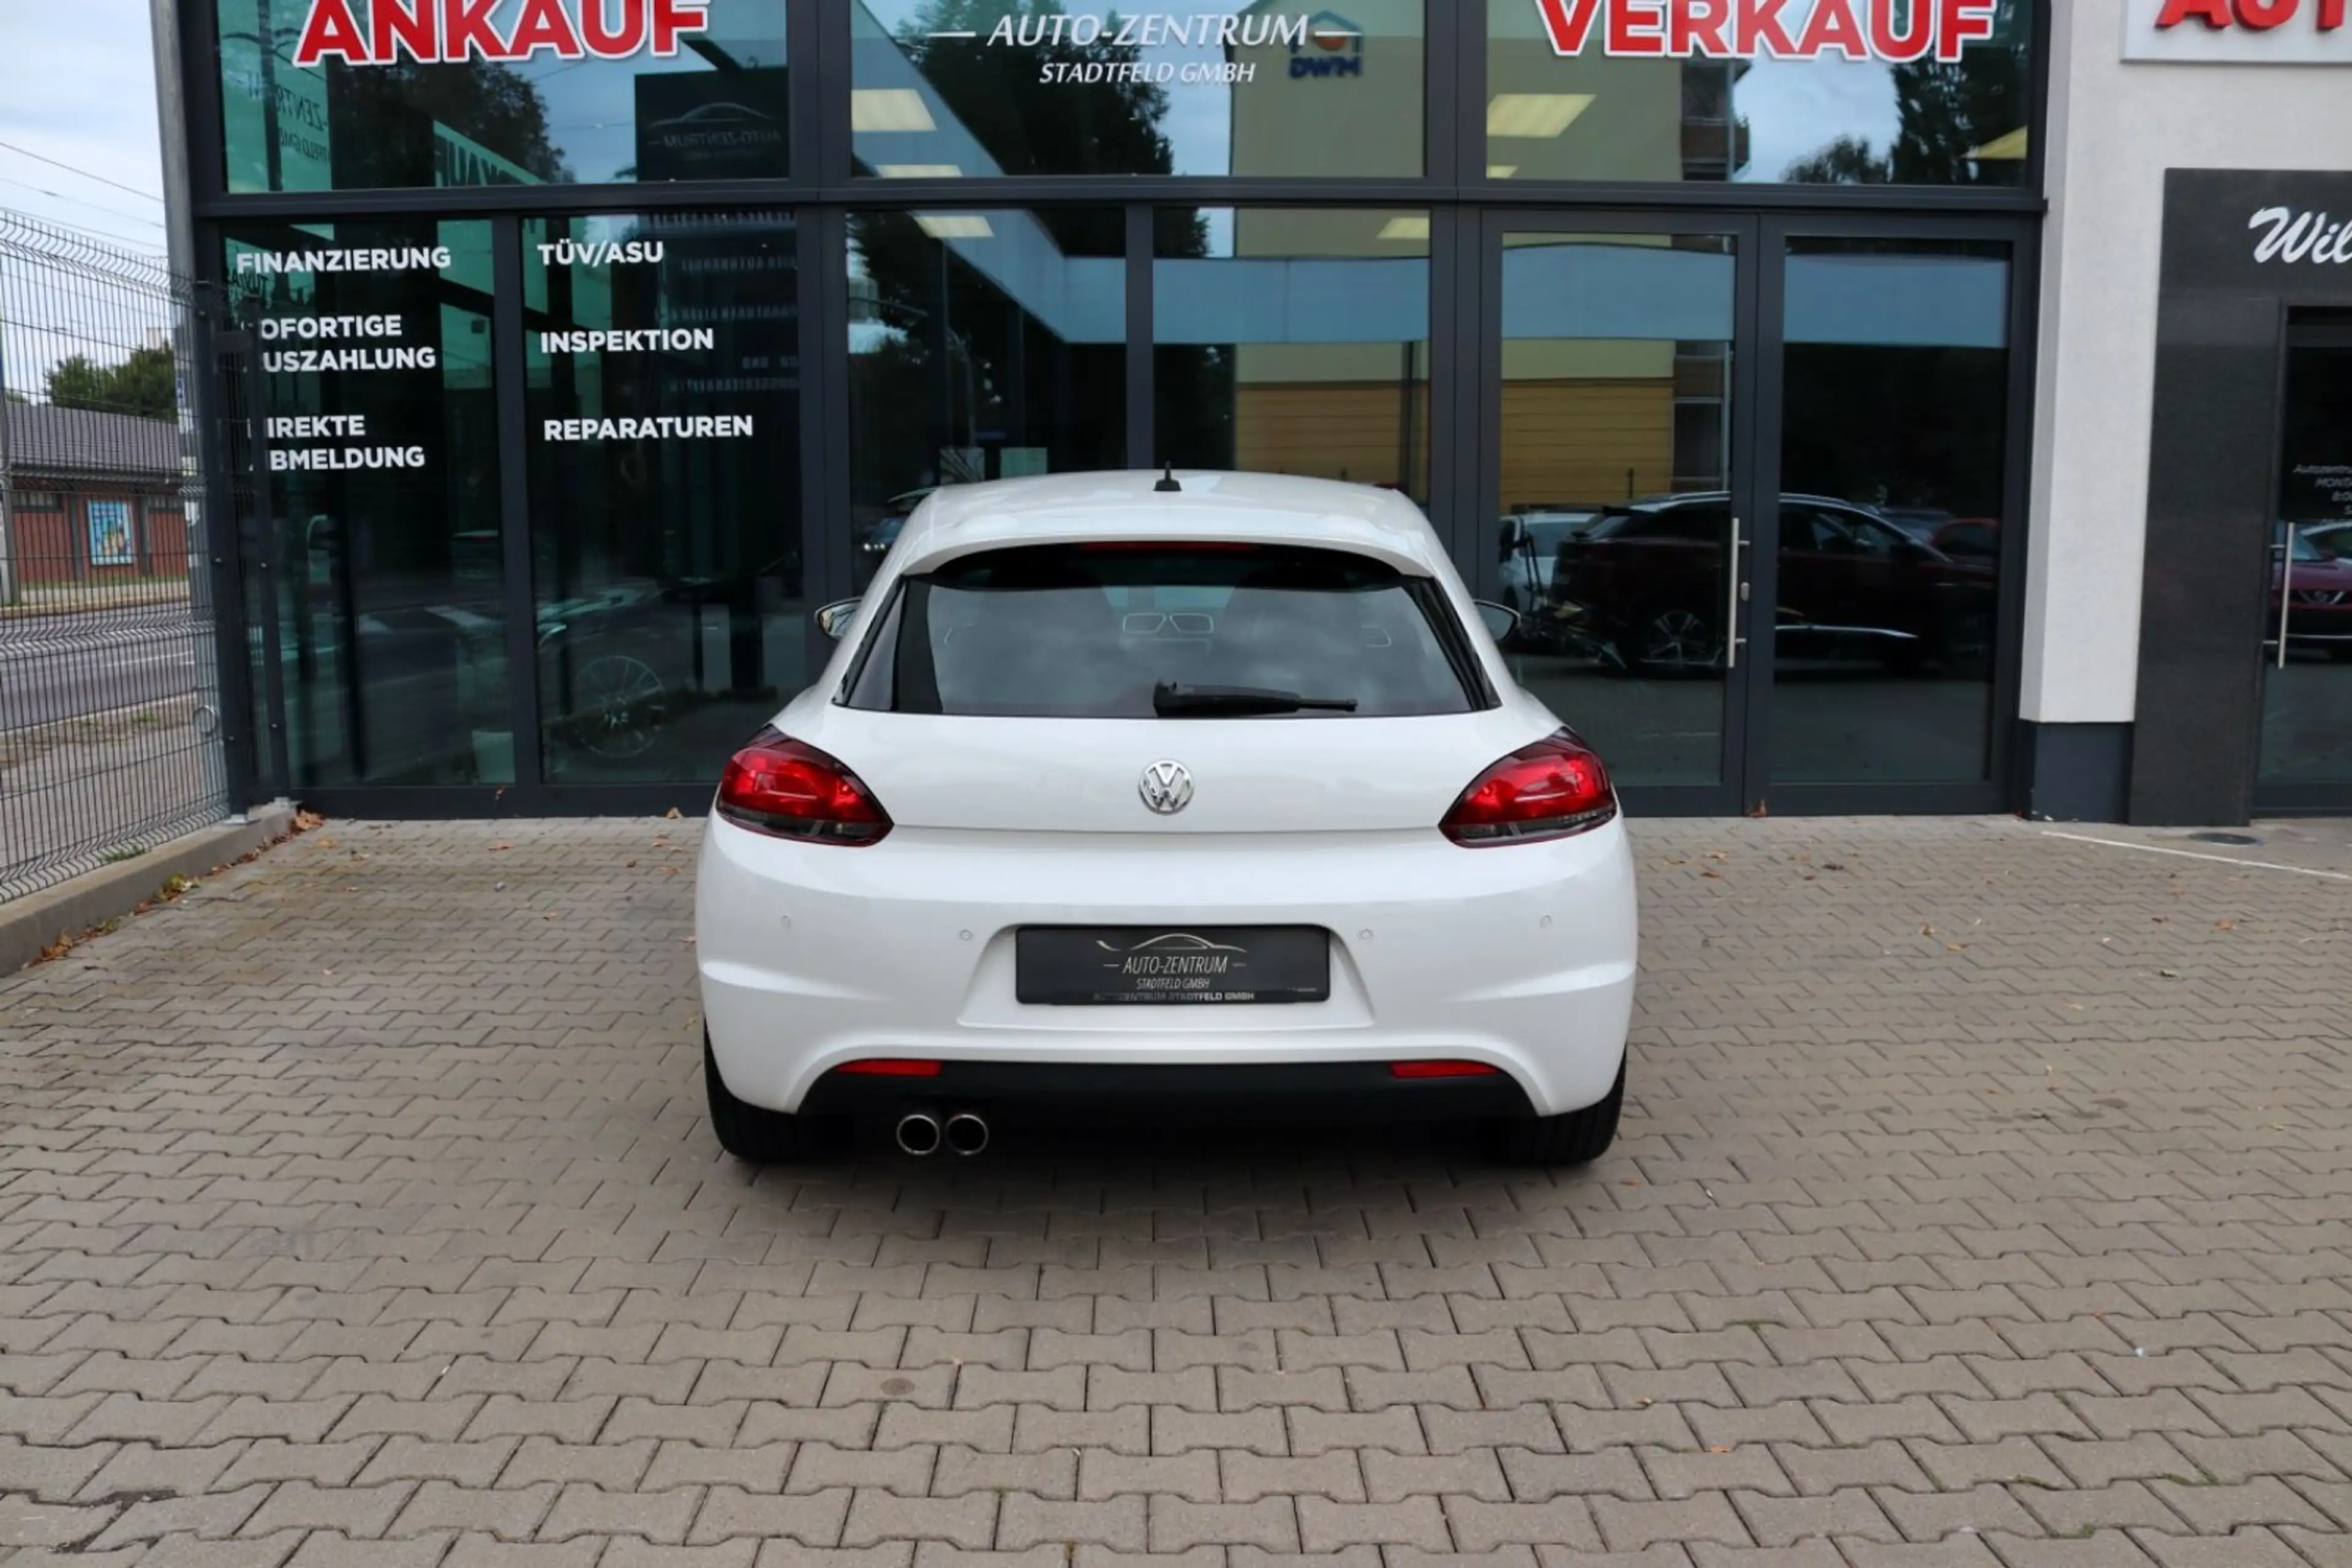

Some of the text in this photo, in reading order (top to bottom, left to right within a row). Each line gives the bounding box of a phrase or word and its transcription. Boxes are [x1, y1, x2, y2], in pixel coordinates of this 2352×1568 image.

[294, 0, 708, 66] ANKAUF
[987, 15, 1308, 46] AUTO-ZENTRUM
[1537, 0, 1997, 63] VERKAUF
[1039, 62, 1256, 83] STADTFELD GMBH
[236, 246, 451, 273] FINANZIERUNG
[537, 238, 663, 268] TÜV/ASU
[242, 314, 402, 340] OFORTIGE
[541, 328, 714, 353] INSPEKTION
[245, 347, 436, 372] USZAHLUNG
[247, 415, 366, 439] IREKTE
[544, 415, 753, 441] REPARATUREN
[249, 446, 425, 472] BMELDUNG
[1123, 956, 1228, 974] AUTO-ZENTRUM
[1136, 978, 1210, 989] STADTFELD GMBH
[1224, 992, 1255, 1001] GMBH
